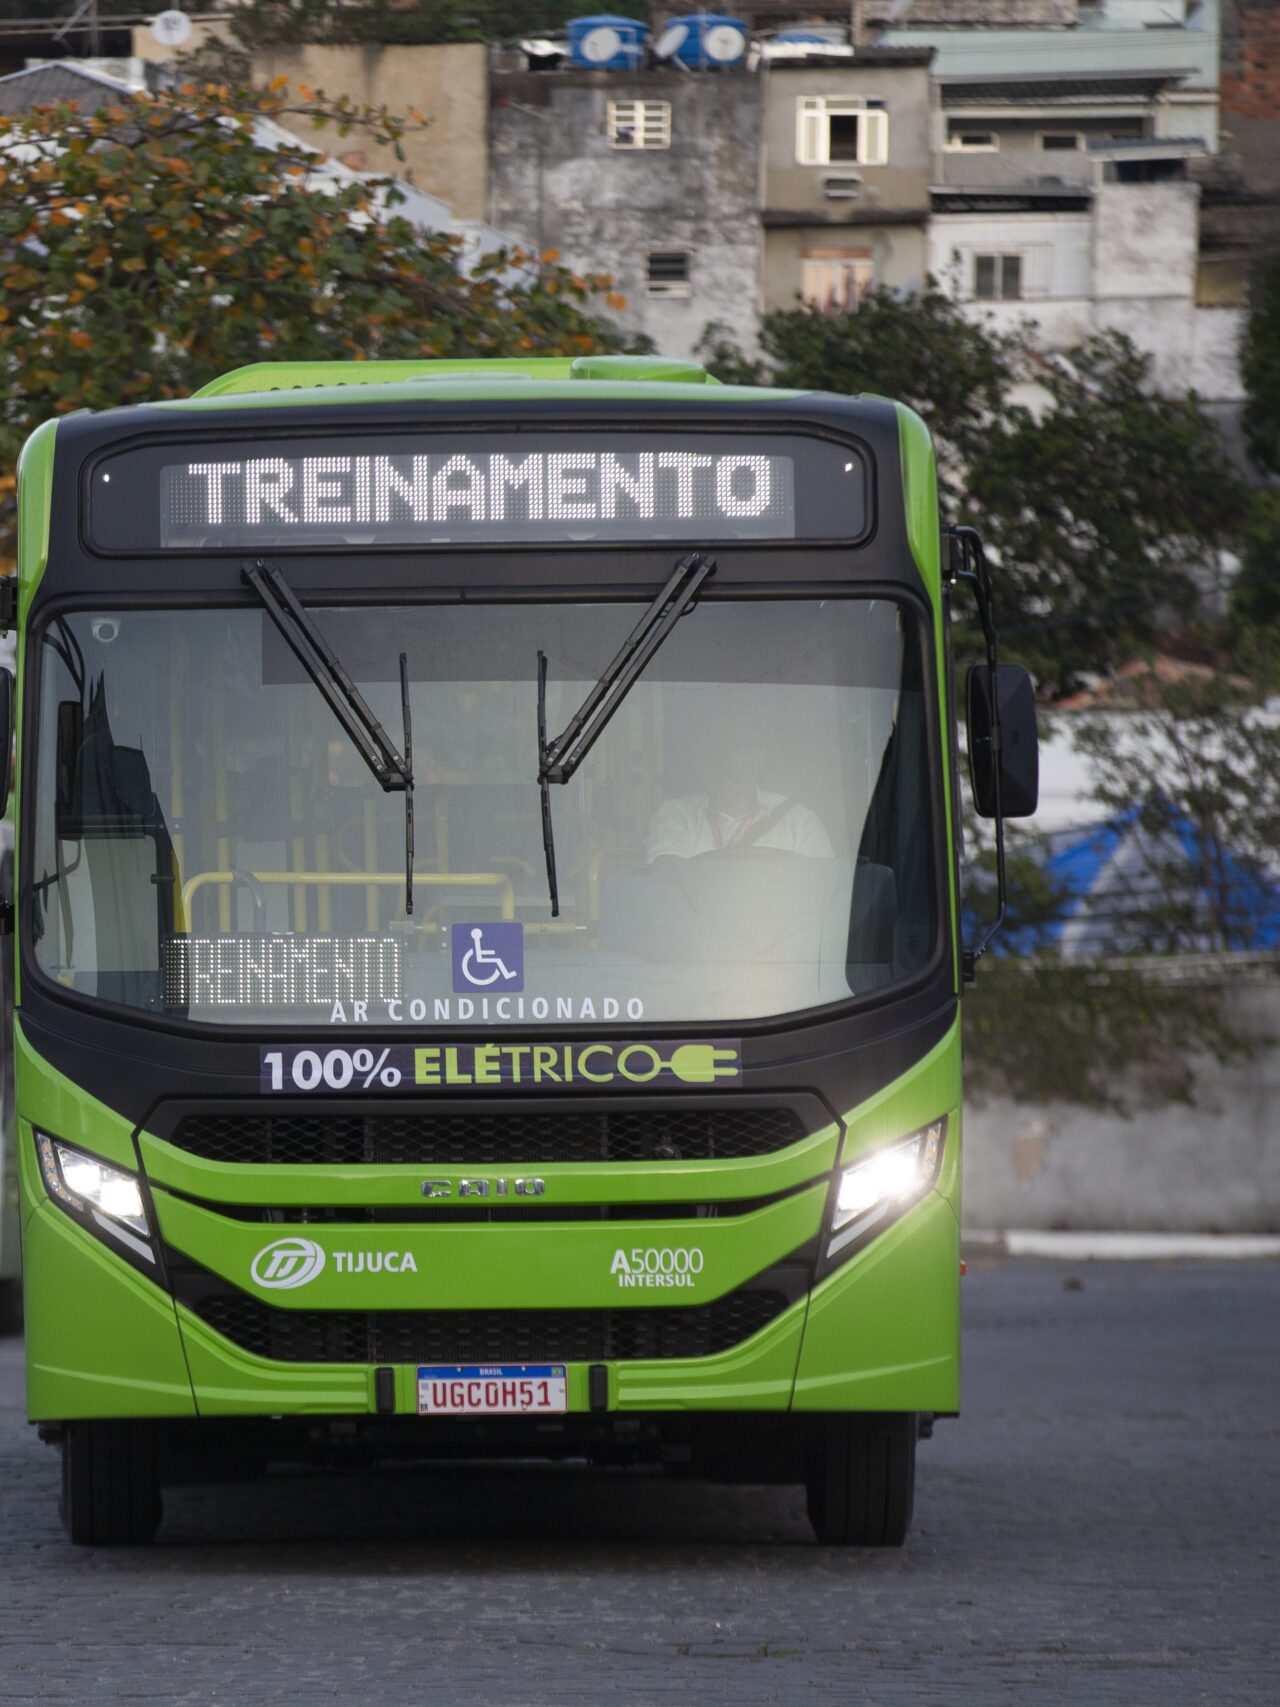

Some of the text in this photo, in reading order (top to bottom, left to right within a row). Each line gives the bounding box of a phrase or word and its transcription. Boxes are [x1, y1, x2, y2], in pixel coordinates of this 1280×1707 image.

[187, 450, 773, 526] TREINAMENTO
[330, 997, 644, 1023] AR CONDICIONADO
[264, 1043, 661, 1090] 100% ELÉTRICO
[421, 1178, 545, 1197] CAIO
[332, 1251, 418, 1273] TIJUCA
[610, 1247, 704, 1274] A50000
[618, 1274, 696, 1288] INTERSUL
[479, 1367, 503, 1376] BRASIL
